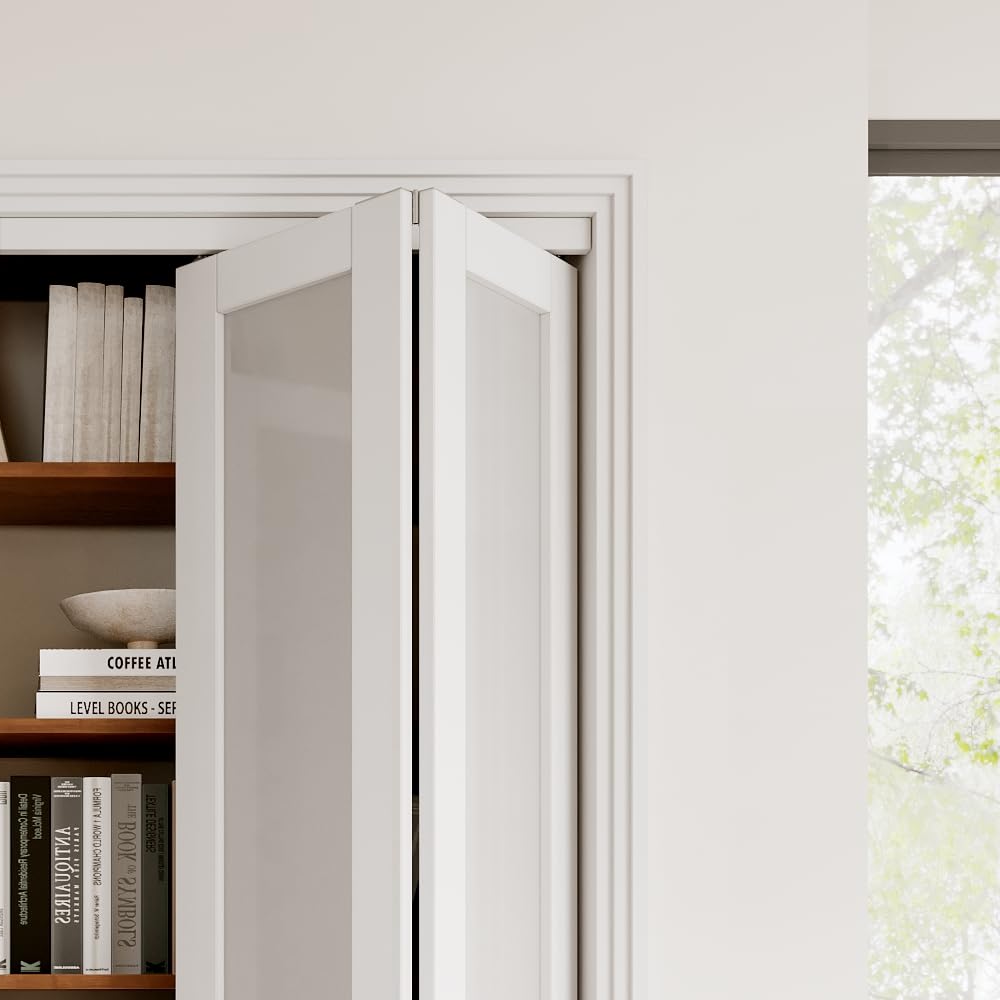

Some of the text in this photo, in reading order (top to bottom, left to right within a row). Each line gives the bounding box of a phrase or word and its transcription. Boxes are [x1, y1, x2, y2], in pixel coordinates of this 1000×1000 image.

[107, 656, 151, 670] COFFEE
[70, 701, 104, 715] LEVEL
[108, 701, 148, 715] BOOKS
